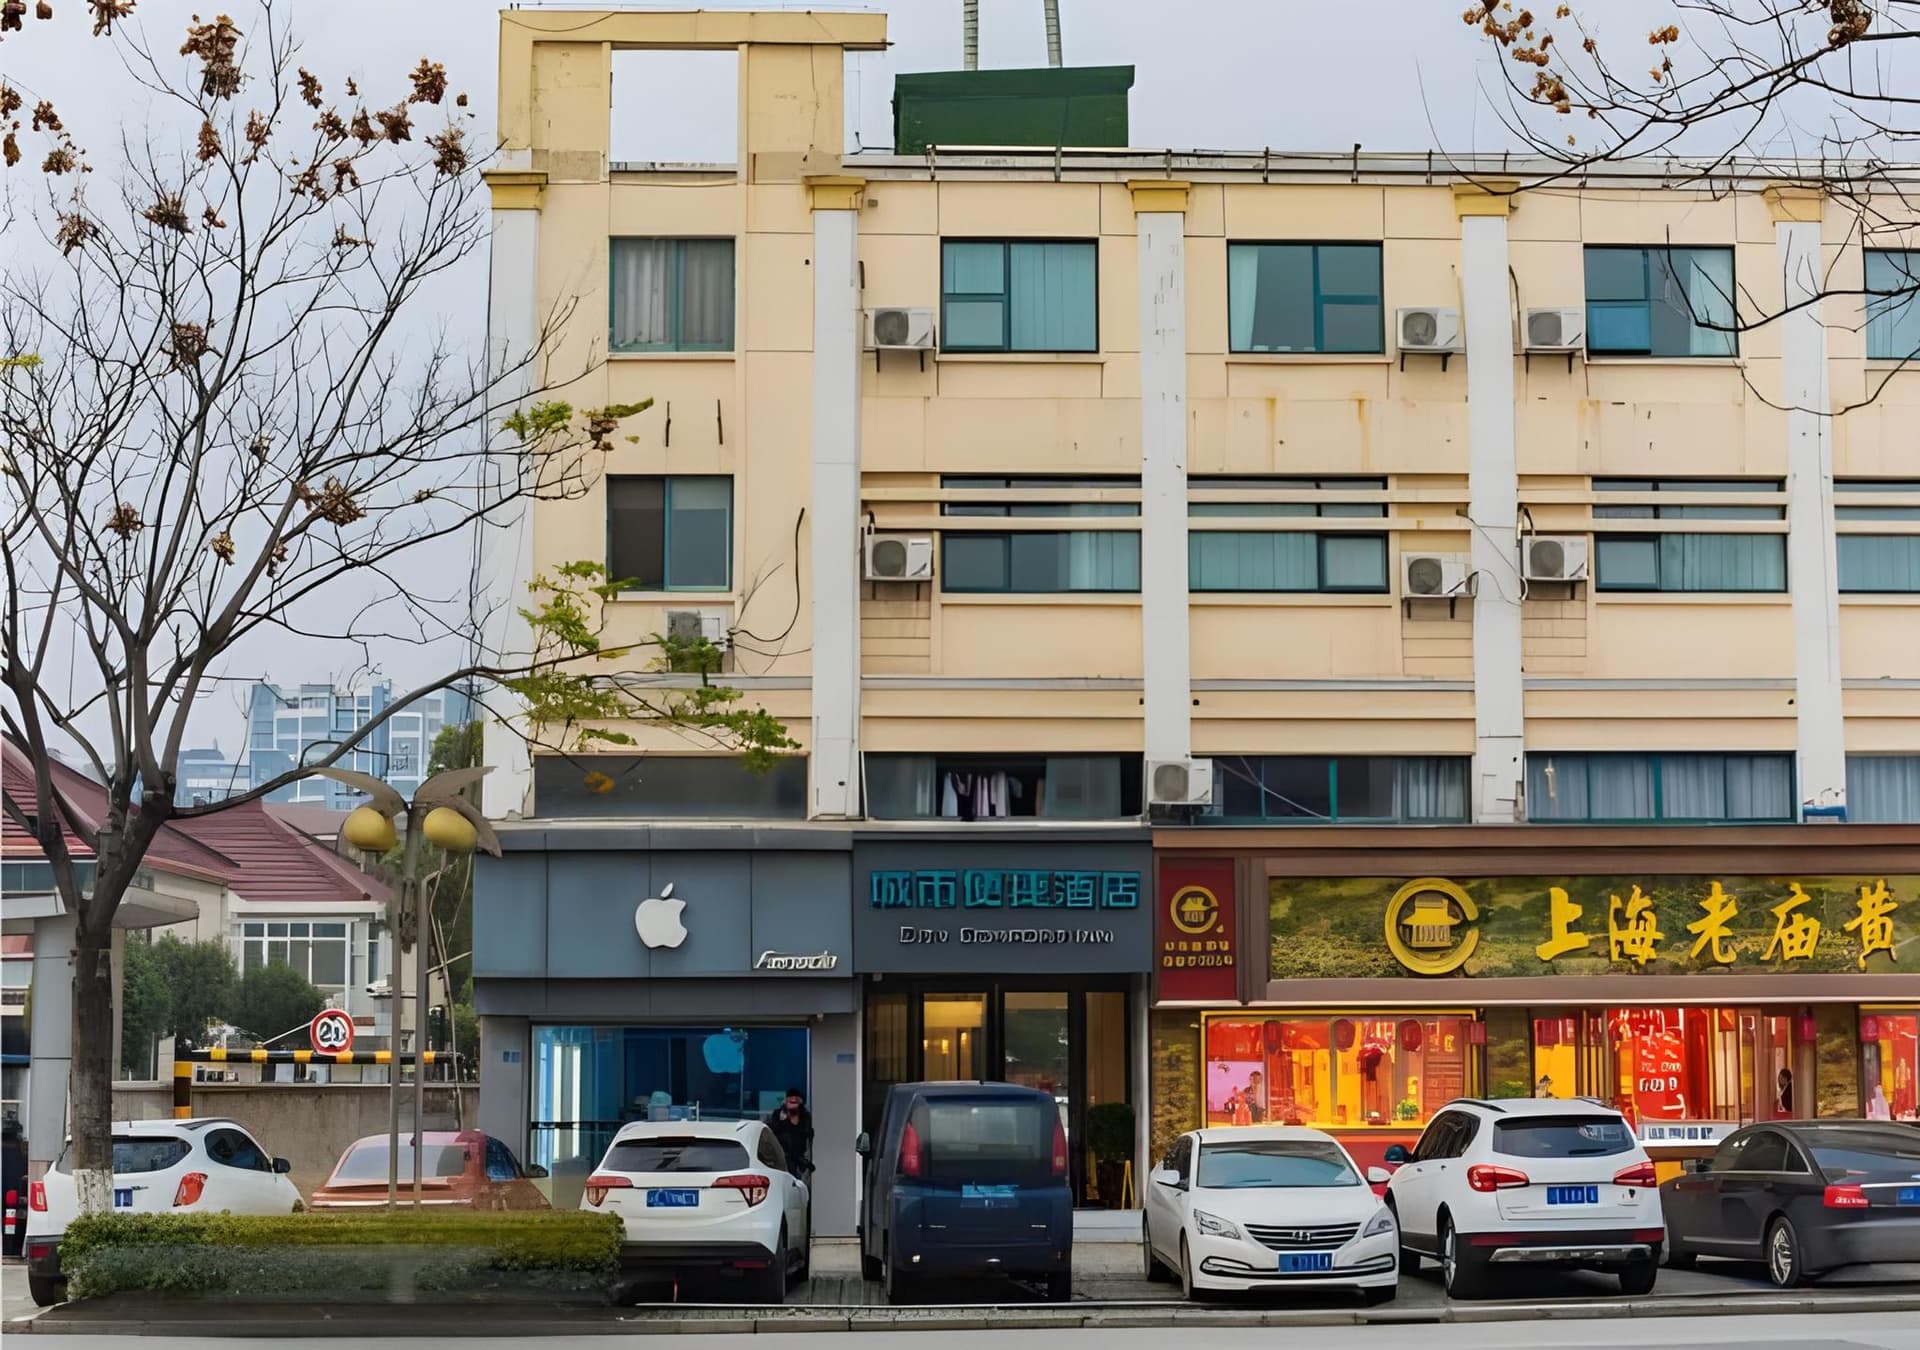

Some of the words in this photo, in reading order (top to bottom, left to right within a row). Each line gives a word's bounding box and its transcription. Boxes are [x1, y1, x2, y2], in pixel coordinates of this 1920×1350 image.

[1536, 879, 1898, 971] 上海老庙黄
